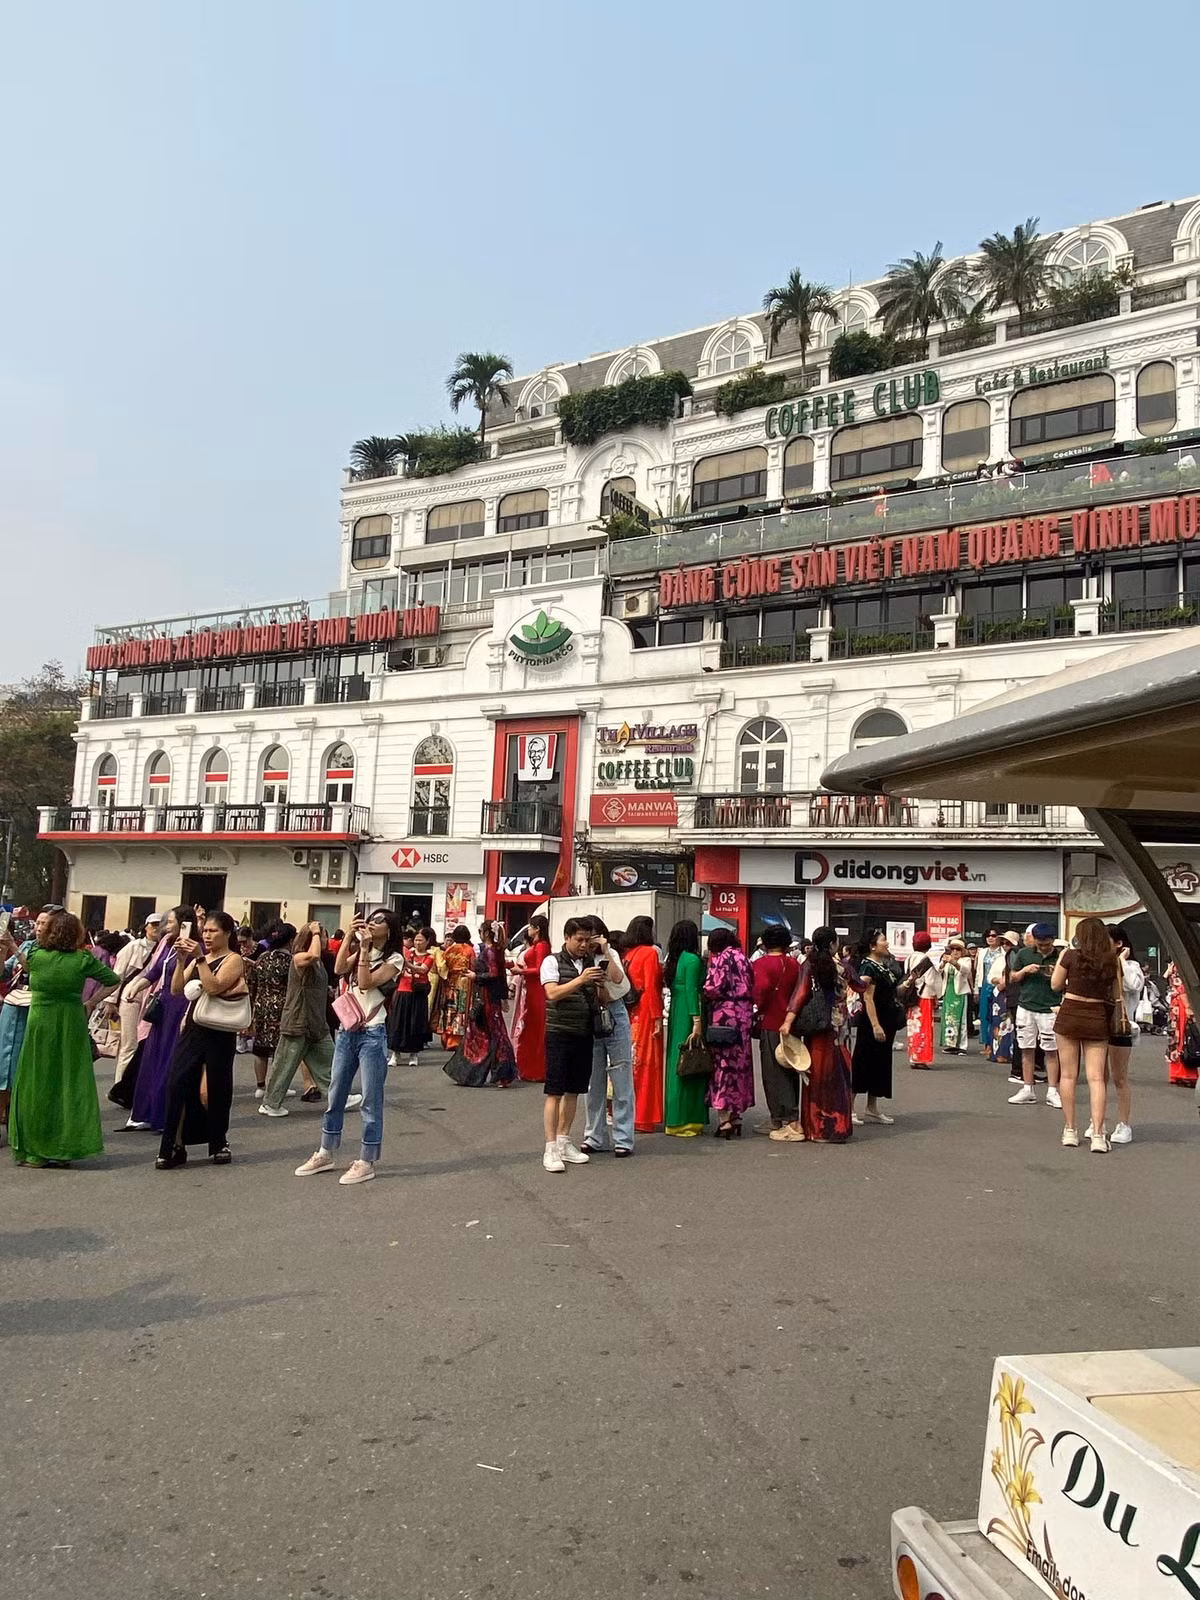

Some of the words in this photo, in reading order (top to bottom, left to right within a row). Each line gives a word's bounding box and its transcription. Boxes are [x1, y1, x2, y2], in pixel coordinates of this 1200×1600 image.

[975, 373, 1009, 395] Café
[1013, 369, 1024, 387] &
[1029, 348, 1110, 384] Restaurant
[765, 389, 855, 439] COFFEE
[872, 370, 940, 416] CLUB
[1053, 446, 1093, 459] Cocktails
[952, 470, 977, 480] Coffee
[660, 561, 715, 609] ĐẢNG
[790, 542, 837, 590] SẢN
[844, 534, 895, 585] VIỆT
[901, 531, 961, 576] NAM
[967, 515, 1060, 573] QUANG
[1071, 504, 1140, 553] VINH
[1149, 496, 1200, 545] MU
[316, 617, 350, 646] NAM
[355, 605, 399, 644] MUÔN
[402, 600, 440, 639] NĂM
[508, 643, 574, 667] PHYTOPHARCO
[597, 760, 651, 780] COFFEE
[656, 758, 694, 777] CLUB
[423, 853, 449, 863] HSBC
[496, 876, 546, 896] KFC
[720, 892, 736, 904] 03
[1050, 1430, 1140, 1548] Du
